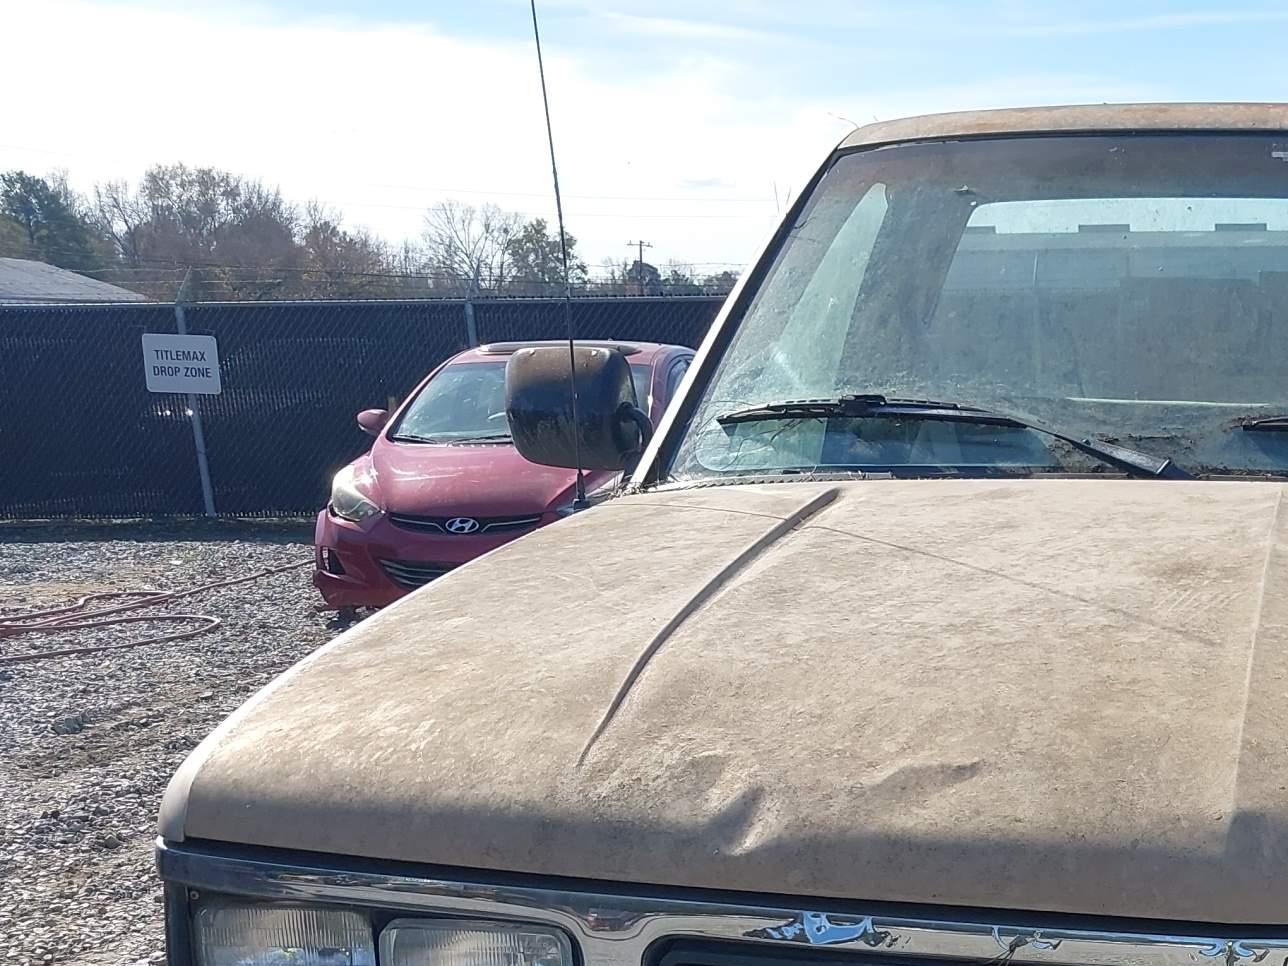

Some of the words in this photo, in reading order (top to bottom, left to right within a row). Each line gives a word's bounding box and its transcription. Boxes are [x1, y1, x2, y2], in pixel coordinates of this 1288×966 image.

[153, 349, 207, 362] TITLEMAX
[152, 365, 181, 377] DROP
[183, 367, 212, 378] ZONE
